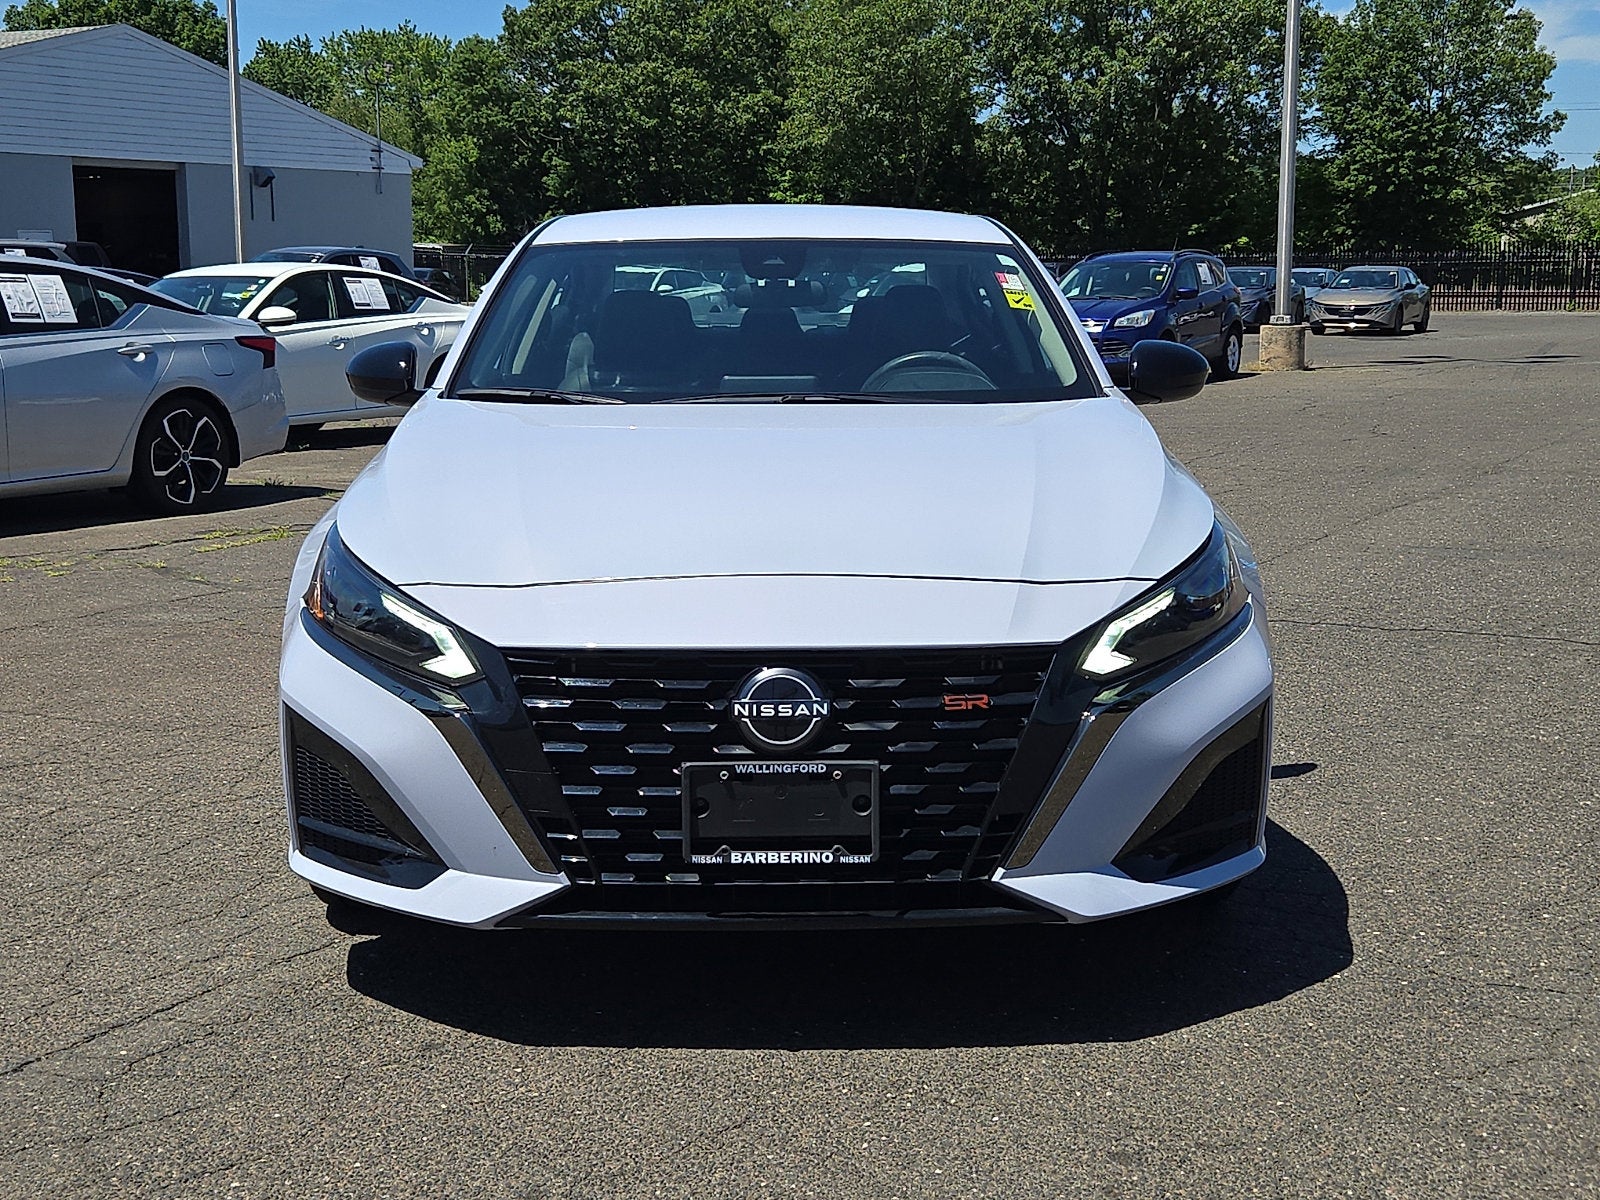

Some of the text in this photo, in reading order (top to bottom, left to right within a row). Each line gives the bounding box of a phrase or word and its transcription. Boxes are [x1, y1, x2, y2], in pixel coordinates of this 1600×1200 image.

[943, 694, 990, 710] SR
[734, 703, 828, 717] NISSAN
[735, 764, 827, 774] WALLINGFORD
[691, 852, 871, 864] NISSAN BARBERINO NISSAN
